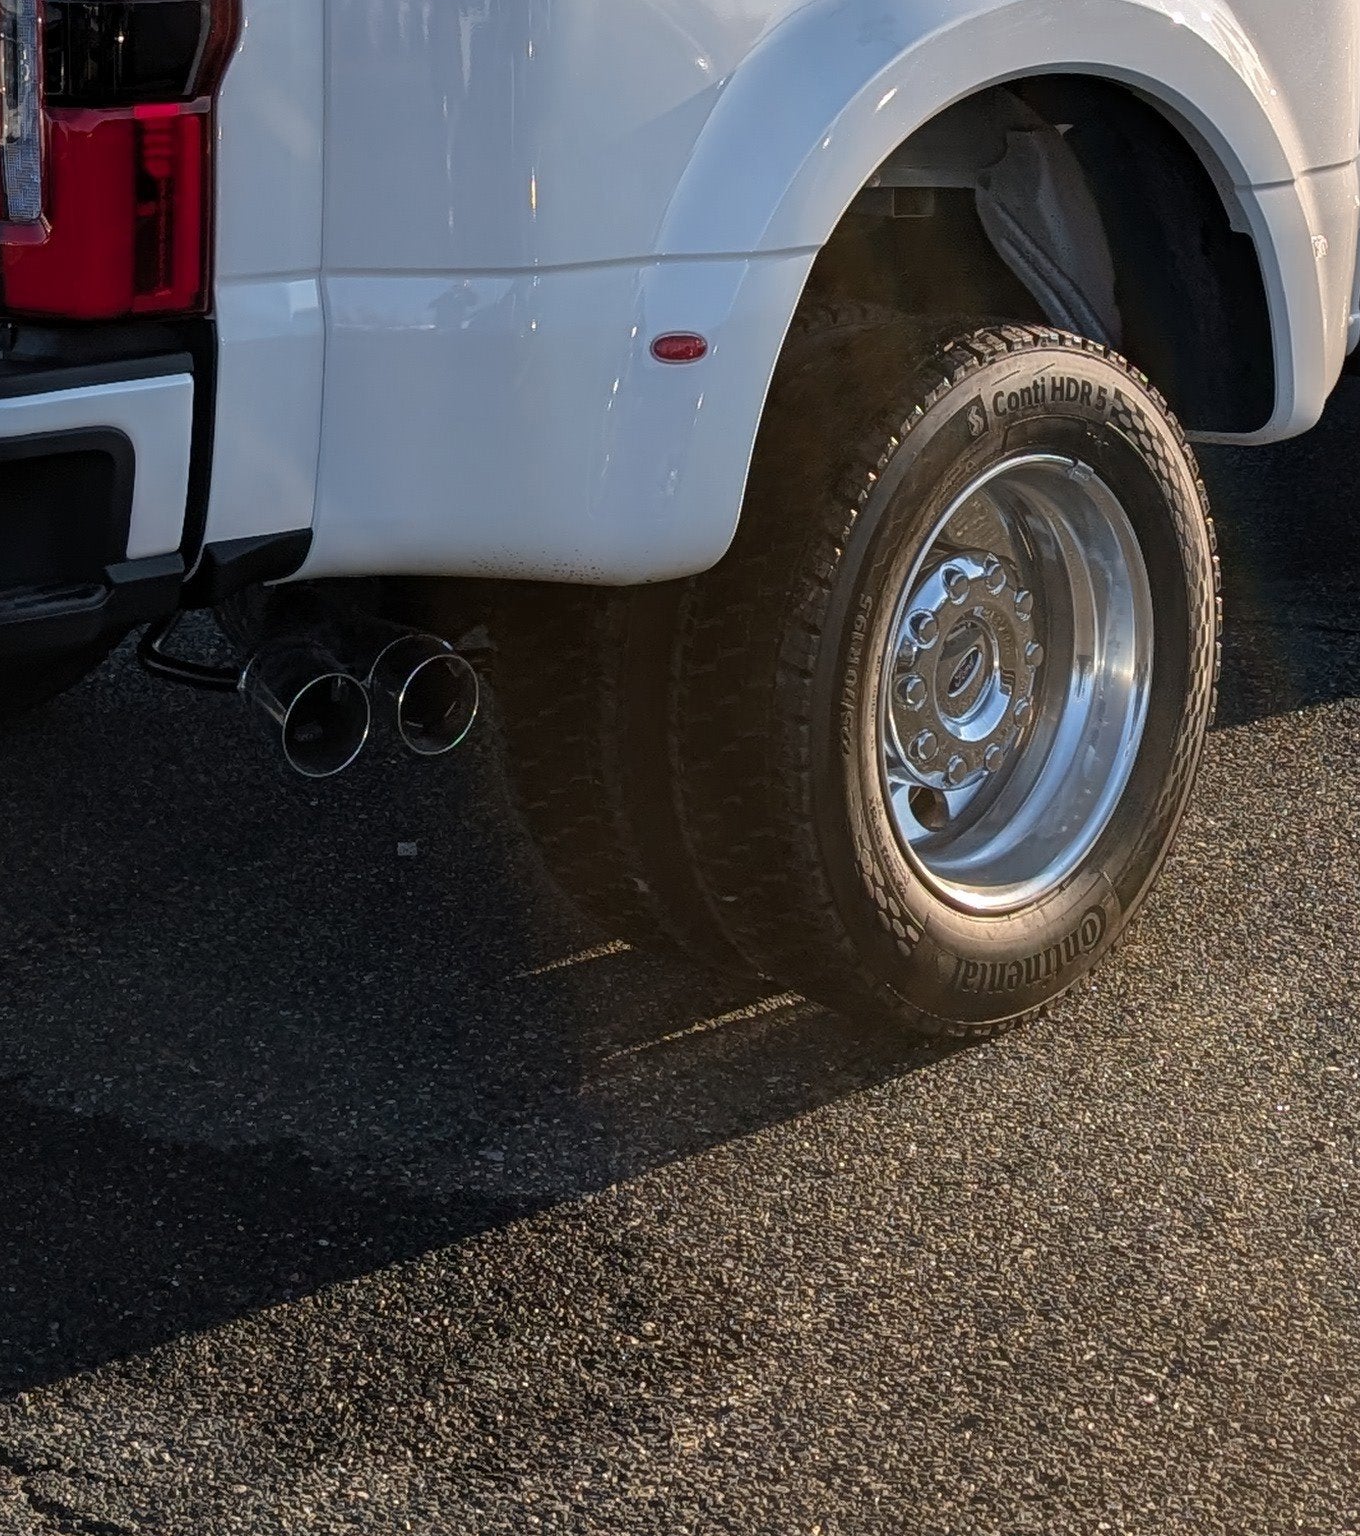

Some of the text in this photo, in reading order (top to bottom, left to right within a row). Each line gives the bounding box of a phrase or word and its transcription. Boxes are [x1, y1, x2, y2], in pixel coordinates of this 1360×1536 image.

[992, 376, 1108, 418] Conti HDR 5
[954, 904, 1107, 994] Continental
